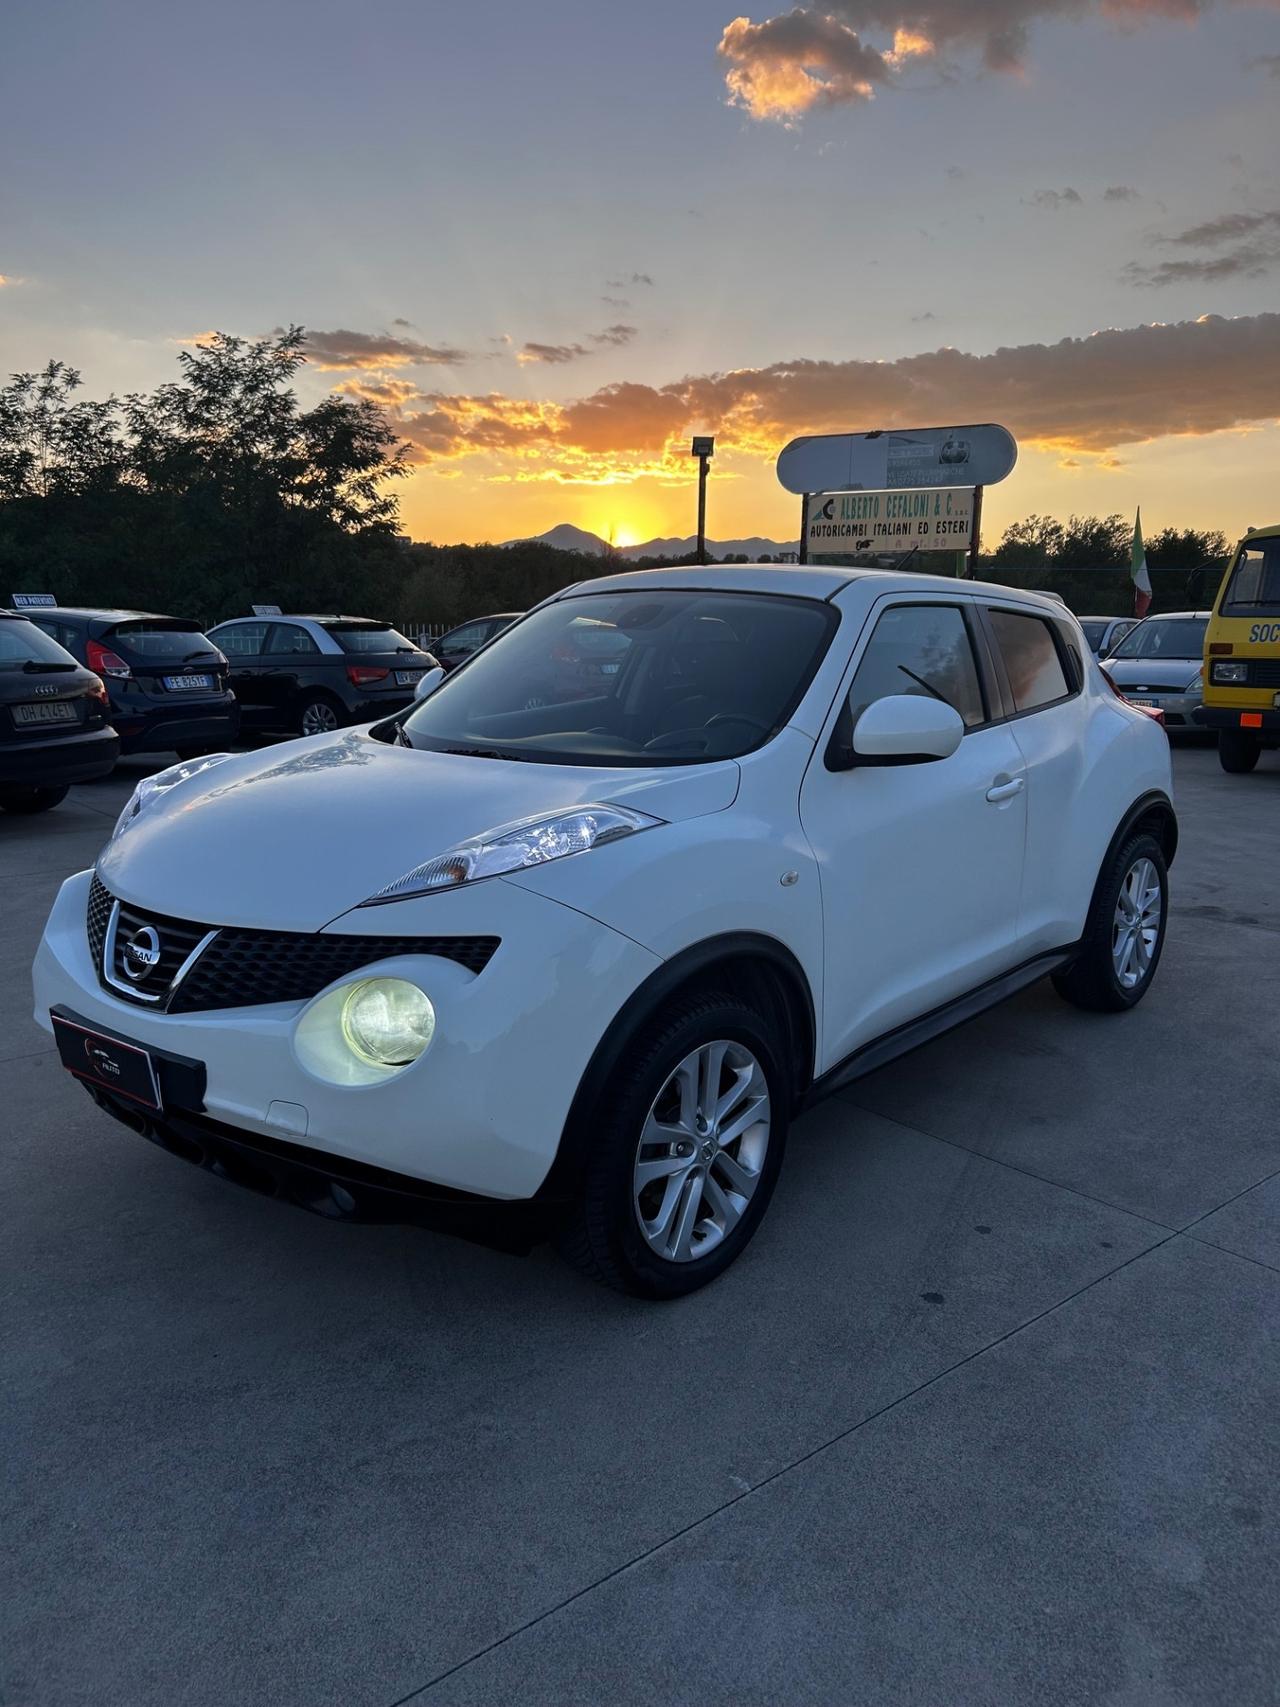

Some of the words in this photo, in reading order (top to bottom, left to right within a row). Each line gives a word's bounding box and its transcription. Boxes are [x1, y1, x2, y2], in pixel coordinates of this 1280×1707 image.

[840, 495, 879, 520] ALBERTO
[886, 494, 929, 517] CEFALONI
[933, 493, 941, 516] &
[810, 524, 867, 537] AUTORICAMBI
[873, 522, 912, 536] ITALIANI
[918, 522, 929, 534] ED
[936, 520, 969, 534] ESTERI
[126, 947, 153, 962] ISSAN
